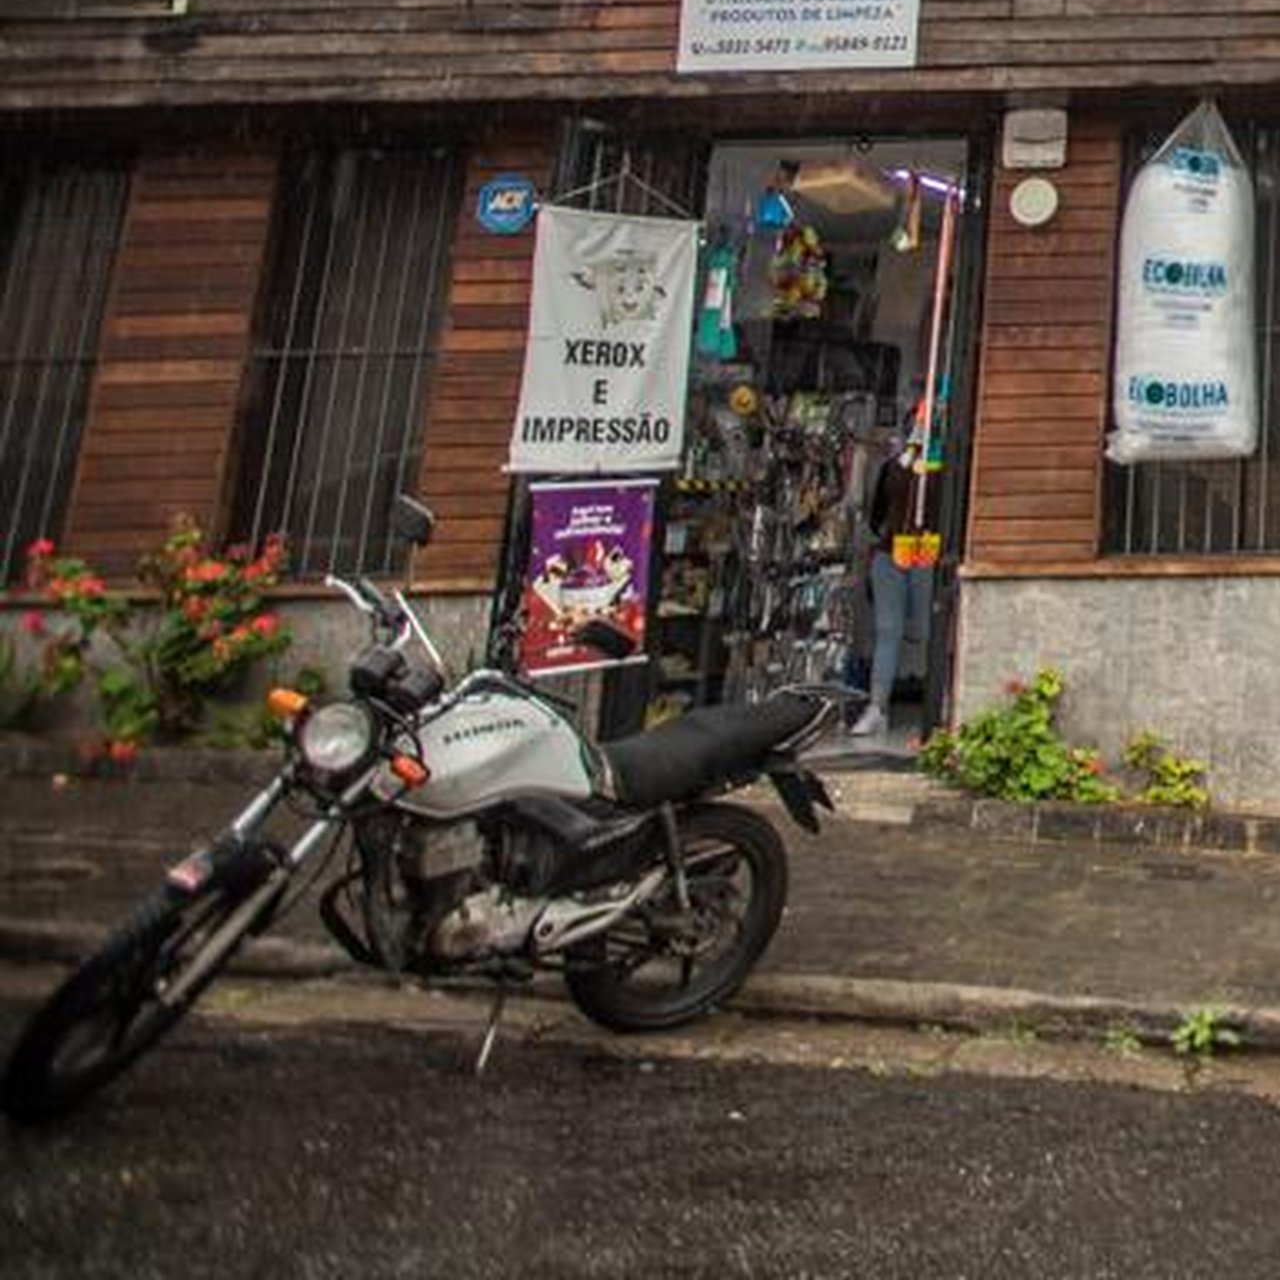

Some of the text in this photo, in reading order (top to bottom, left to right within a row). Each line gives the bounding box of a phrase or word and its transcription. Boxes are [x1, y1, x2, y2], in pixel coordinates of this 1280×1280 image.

[710, 4, 894, 23] PRODUTOS DE LIMPEZA
[564, 338, 646, 368] XEROX
[593, 379, 608, 405] E
[522, 414, 670, 444] IMPRESSÃO
